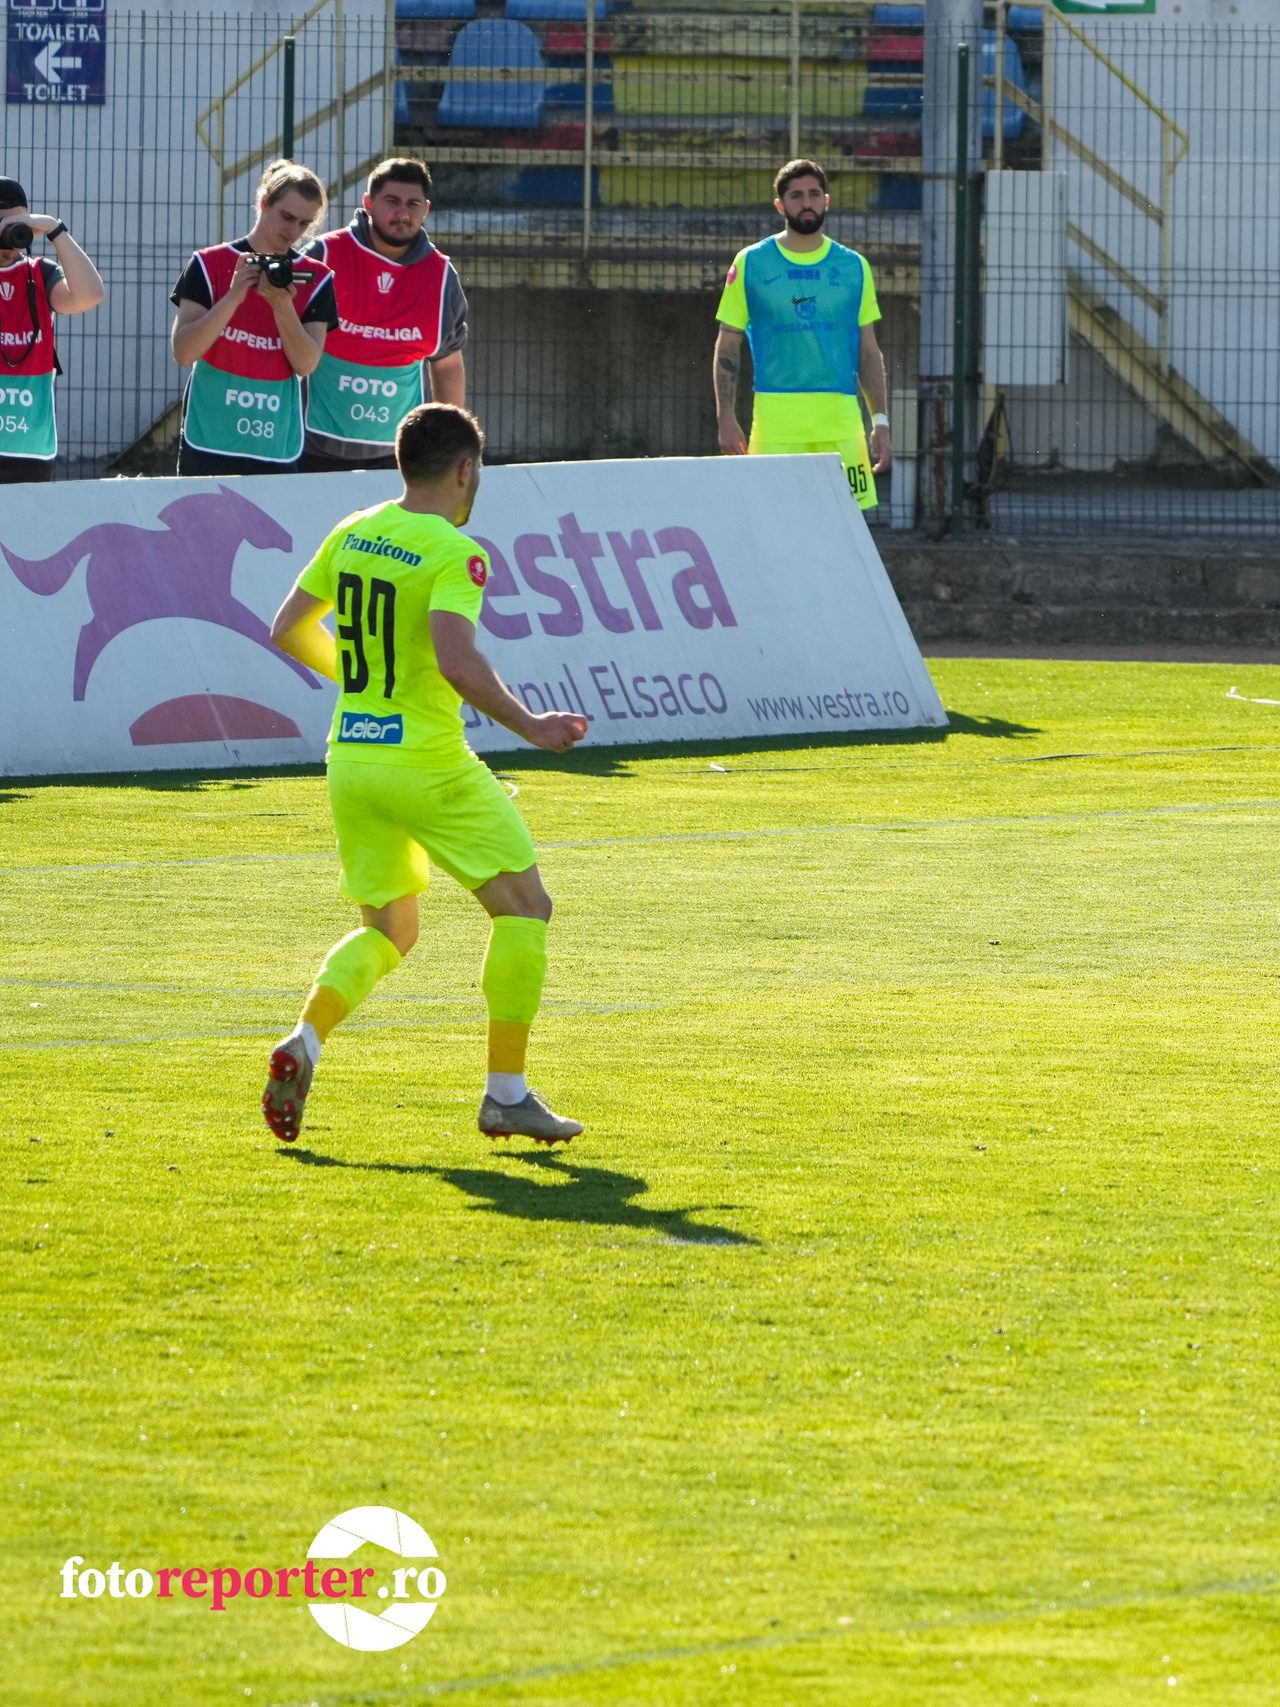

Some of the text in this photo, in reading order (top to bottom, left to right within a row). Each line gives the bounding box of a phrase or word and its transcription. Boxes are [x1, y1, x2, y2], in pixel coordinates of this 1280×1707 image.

[15, 23, 100, 41] TOALETA
[24, 84, 90, 101] TOILET
[219, 326, 282, 350] SUPERLI
[338, 375, 398, 397] FOTO
[225, 389, 280, 412] FOTO
[350, 403, 390, 423] 043
[236, 417, 275, 439] 038
[847, 463, 868, 494] 95
[342, 533, 422, 567] Panifcom
[478, 512, 739, 640] estra
[337, 572, 396, 700] 37
[588, 661, 728, 721] Elsaco
[747, 687, 910, 723] www.vestra.ro
